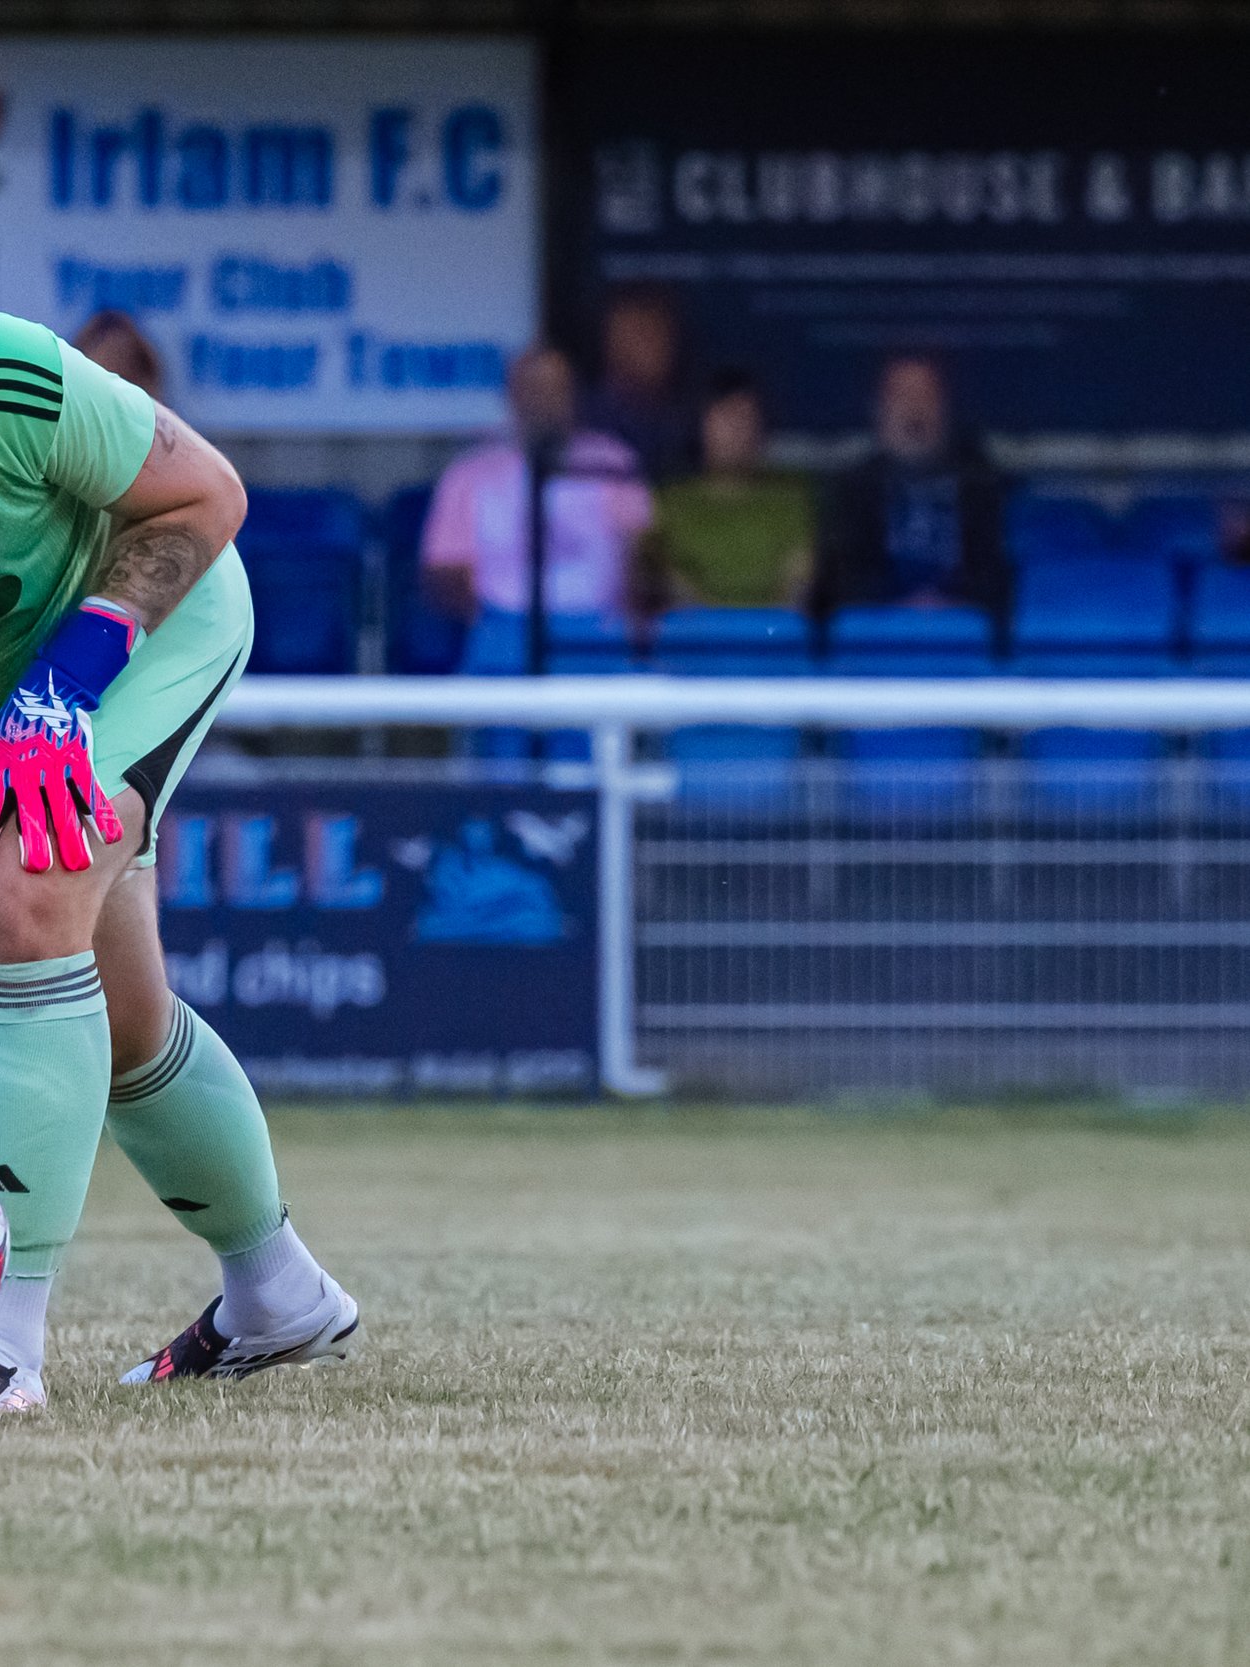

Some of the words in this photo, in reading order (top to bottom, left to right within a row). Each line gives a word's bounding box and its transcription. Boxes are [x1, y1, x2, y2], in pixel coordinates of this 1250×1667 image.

[52, 106, 335, 209] Irlam
[672, 151, 1059, 222] CLUBHOUSE
[1086, 152, 1131, 222] &
[1152, 152, 1250, 222] BA
[213, 256, 352, 312] Club
[235, 938, 387, 1020] chips
